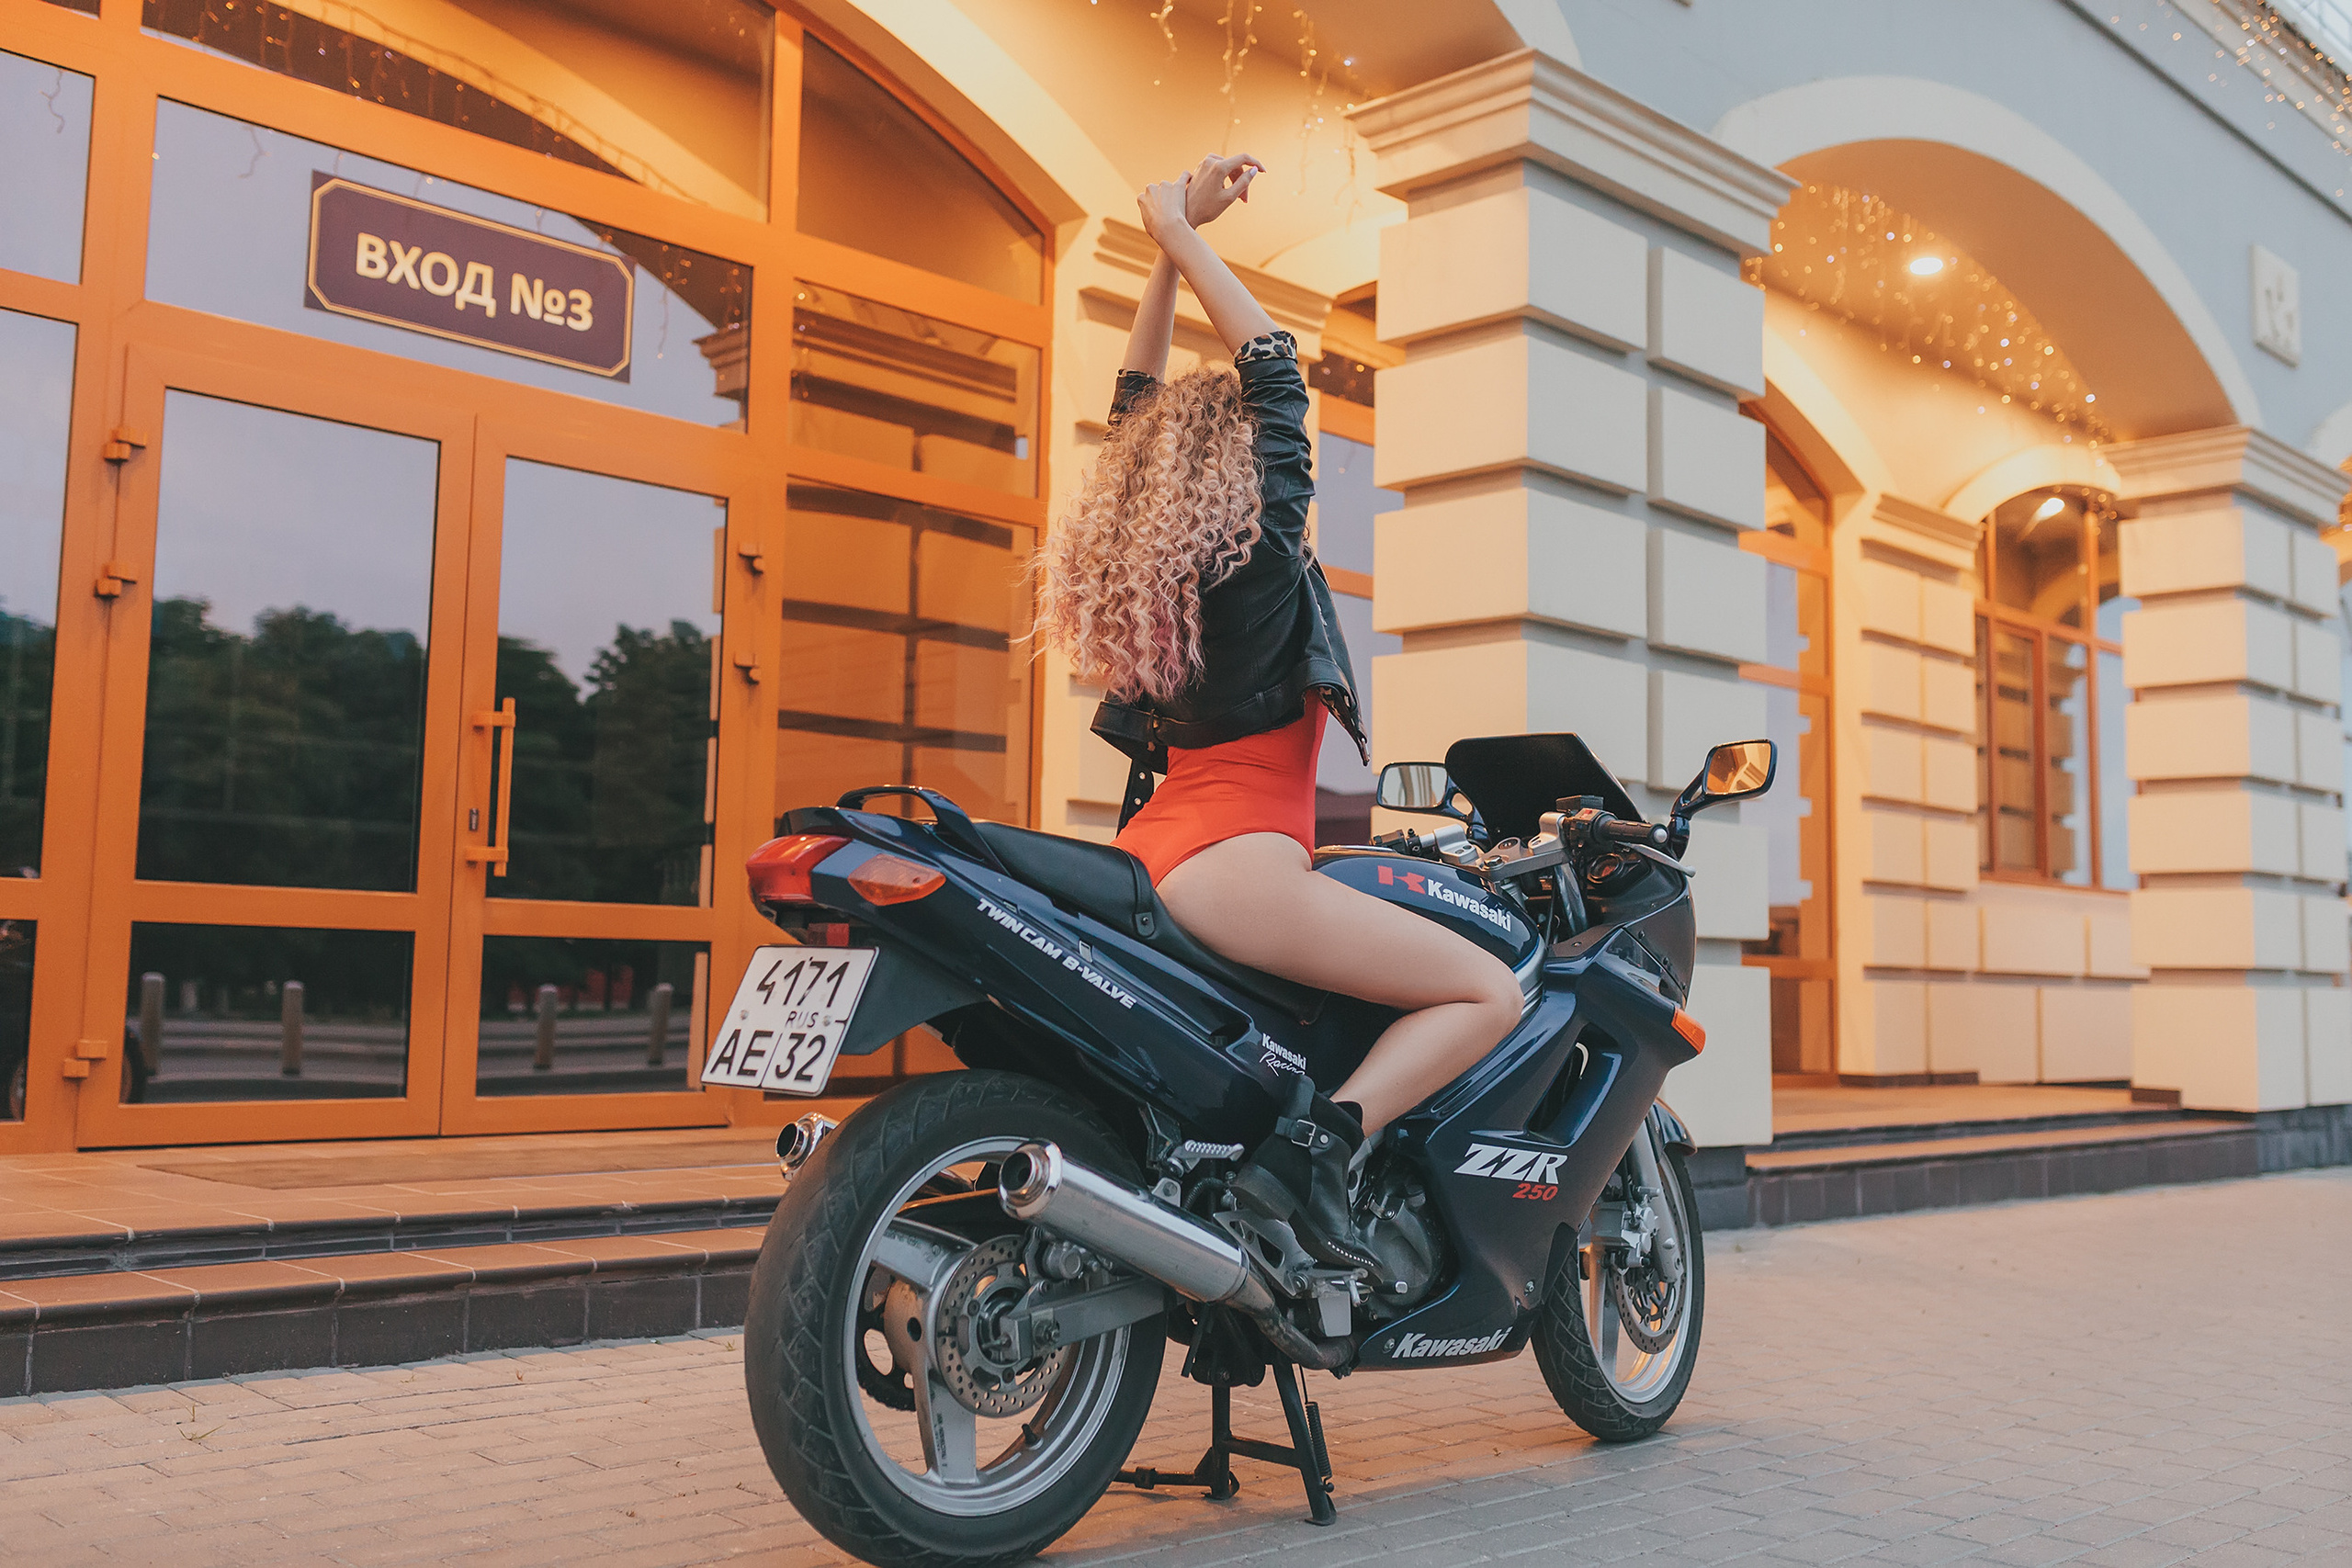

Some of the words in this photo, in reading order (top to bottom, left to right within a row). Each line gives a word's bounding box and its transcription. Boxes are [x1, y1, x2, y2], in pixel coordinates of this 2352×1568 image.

[356, 232, 496, 318] ВХОД
[510, 273, 594, 332] №3
[1427, 879, 1511, 932] Kawasaki
[977, 897, 1024, 934] TWIN
[1019, 929, 1063, 960] CAM
[756, 957, 851, 1009] 4171
[785, 1010, 820, 1029] RUS
[1261, 1032, 1306, 1070] Kawasaki
[1453, 1143, 1568, 1184] ZZR
[1512, 1182, 1558, 1201] 250
[1391, 1325, 1513, 1359] Kawasaki
